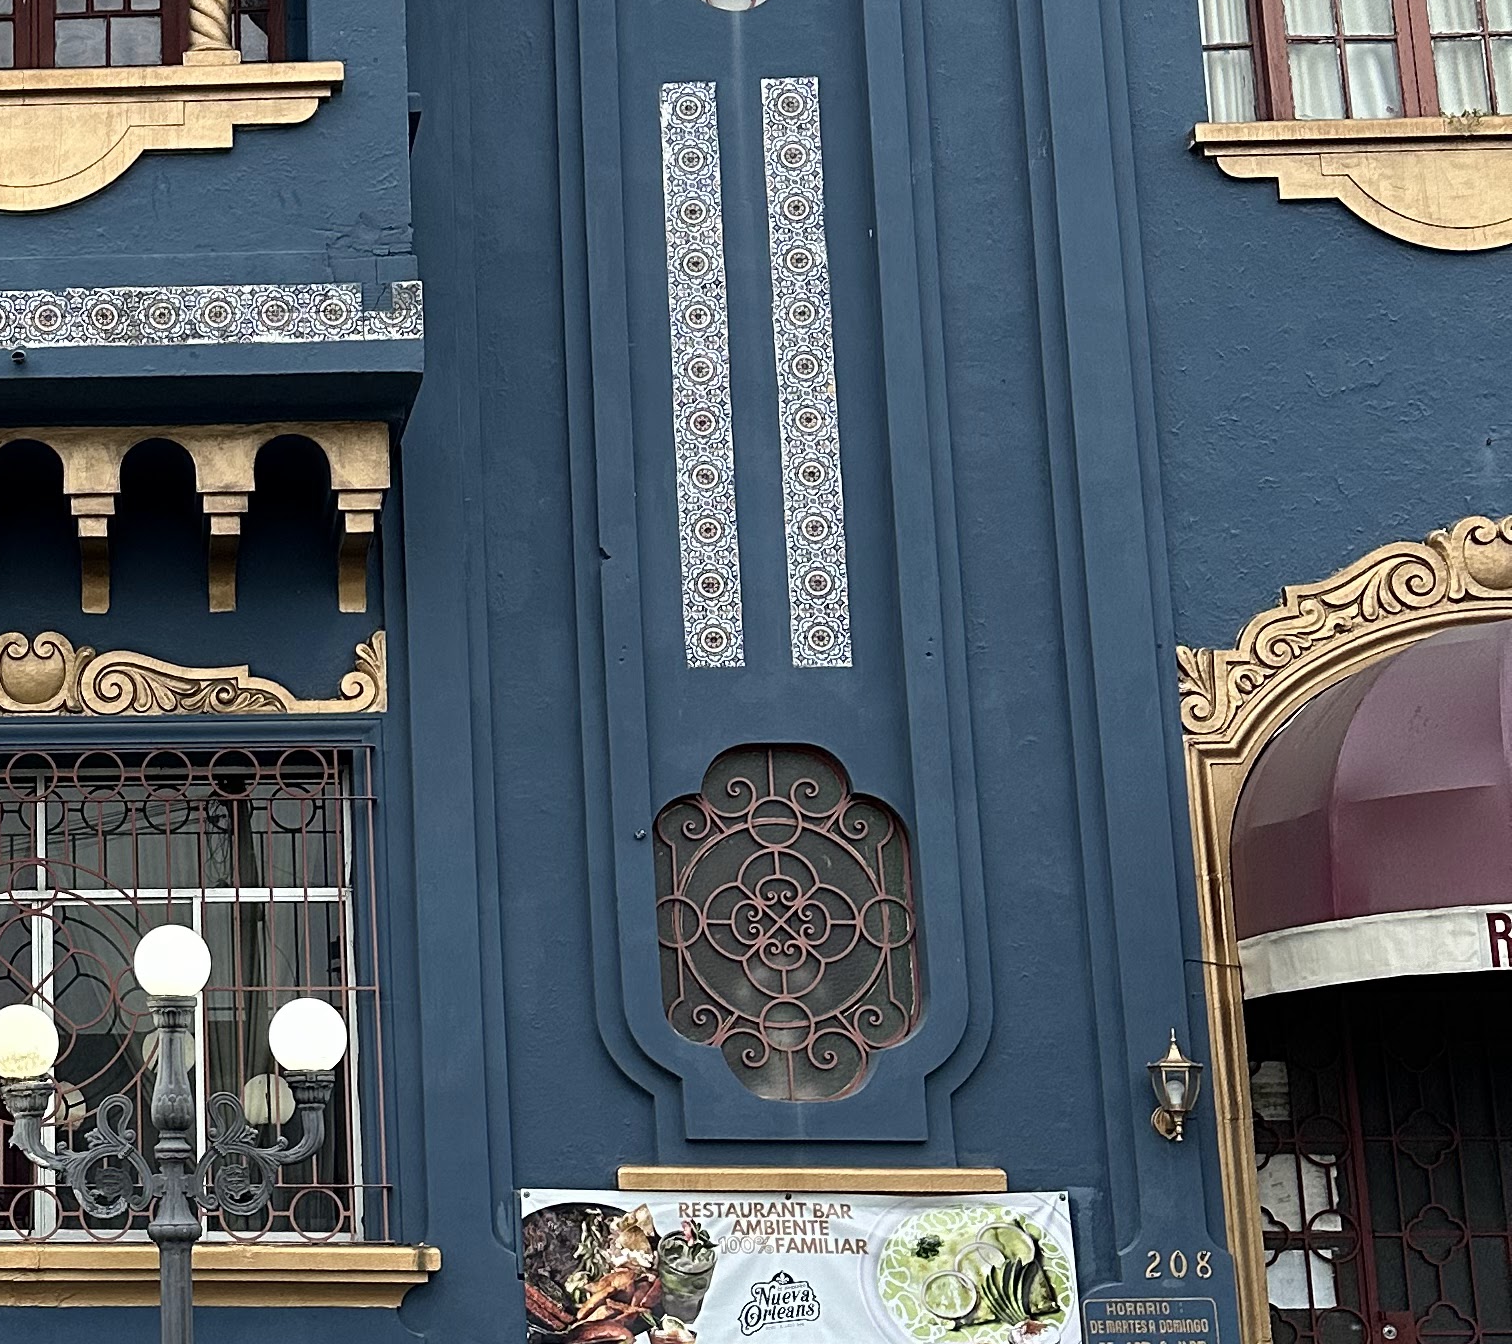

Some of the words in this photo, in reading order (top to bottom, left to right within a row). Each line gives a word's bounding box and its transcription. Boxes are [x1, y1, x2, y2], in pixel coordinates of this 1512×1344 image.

[678, 1202, 806, 1219] RESTAURANT
[812, 1203, 854, 1219] BAR
[731, 1219, 830, 1236] AMBIENTE
[775, 1238, 869, 1255] FAMILIAR
[1145, 1249, 1213, 1279] 208
[754, 1284, 810, 1307] Nueva
[744, 1303, 815, 1330] Orleans
[1090, 1320, 1105, 1334] DE
[1158, 1318, 1209, 1334] DOMINGO
